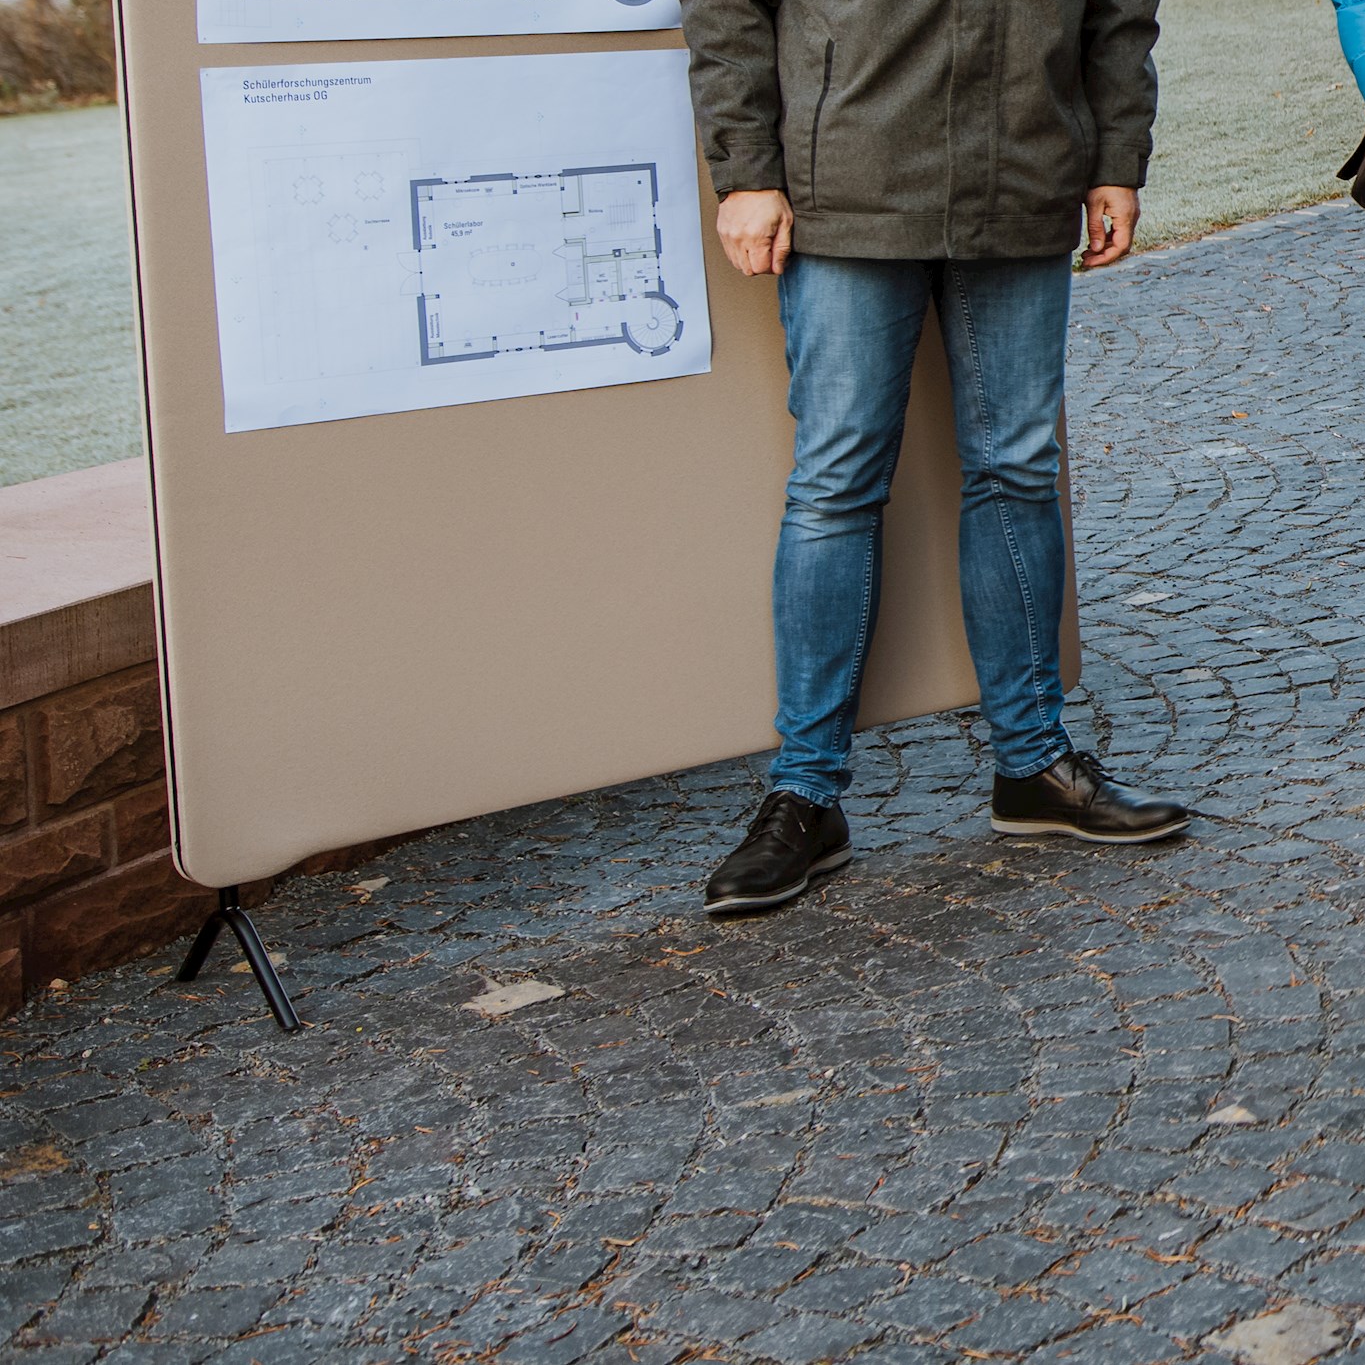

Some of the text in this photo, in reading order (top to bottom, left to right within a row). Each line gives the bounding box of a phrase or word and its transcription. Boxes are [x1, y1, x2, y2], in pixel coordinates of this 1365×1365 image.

[242, 75, 372, 91] Schülerforschungszentrum
[244, 90, 328, 104] Kutscherhaus OG
[443, 220, 484, 230] Schülerlabor
